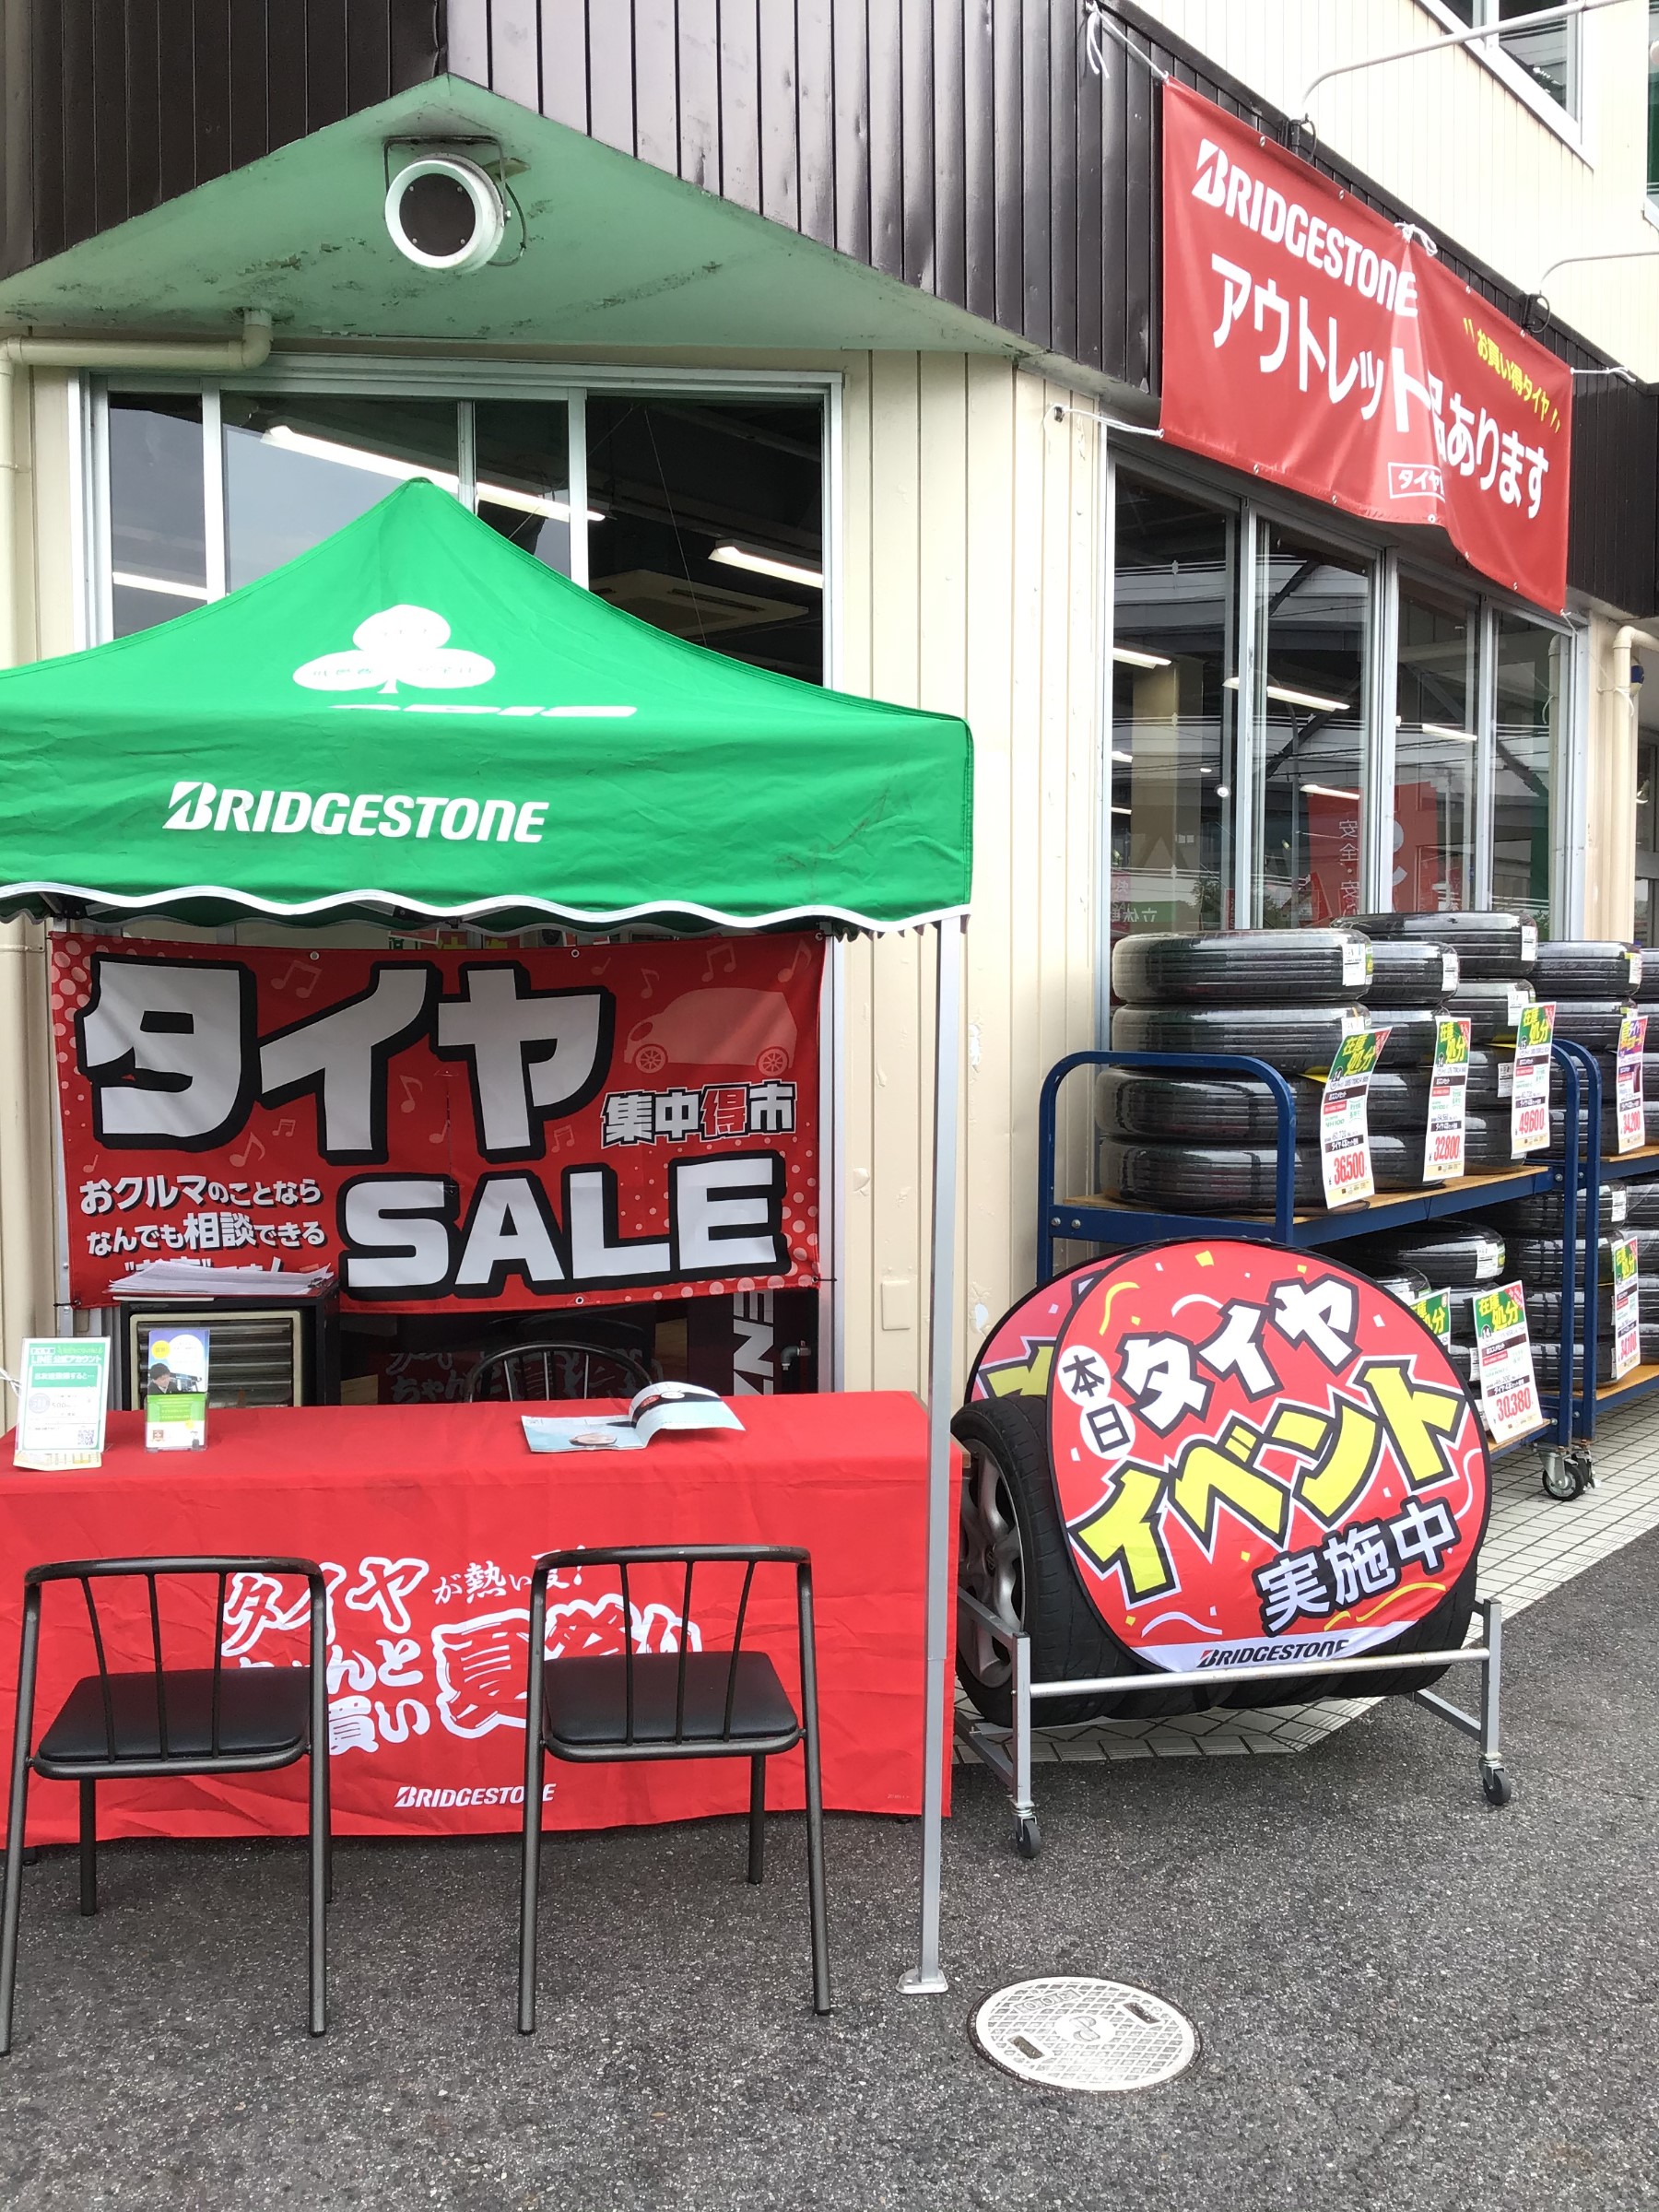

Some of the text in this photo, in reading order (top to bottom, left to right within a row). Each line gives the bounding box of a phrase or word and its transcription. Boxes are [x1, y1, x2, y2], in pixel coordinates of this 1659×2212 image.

[1191, 138, 1419, 317] BRIDGESTONE
[1397, 468, 1444, 496] タイヤ
[162, 781, 549, 843] BRIDGESTONE
[76, 953, 613, 1161] タイヤ
[602, 1079, 798, 1148] 集中得市
[79, 1174, 323, 1215] おクルマのことなら
[87, 1211, 327, 1257] なんでも相談できる
[338, 1150, 790, 1304] SALE
[1059, 1353, 1128, 1453] 本日
[1116, 1275, 1361, 1437] タイヤ
[1069, 1358, 1470, 1606] イベント
[1253, 1498, 1461, 1635] 実施中
[394, 1783, 557, 1808] BRIDGESTOE
